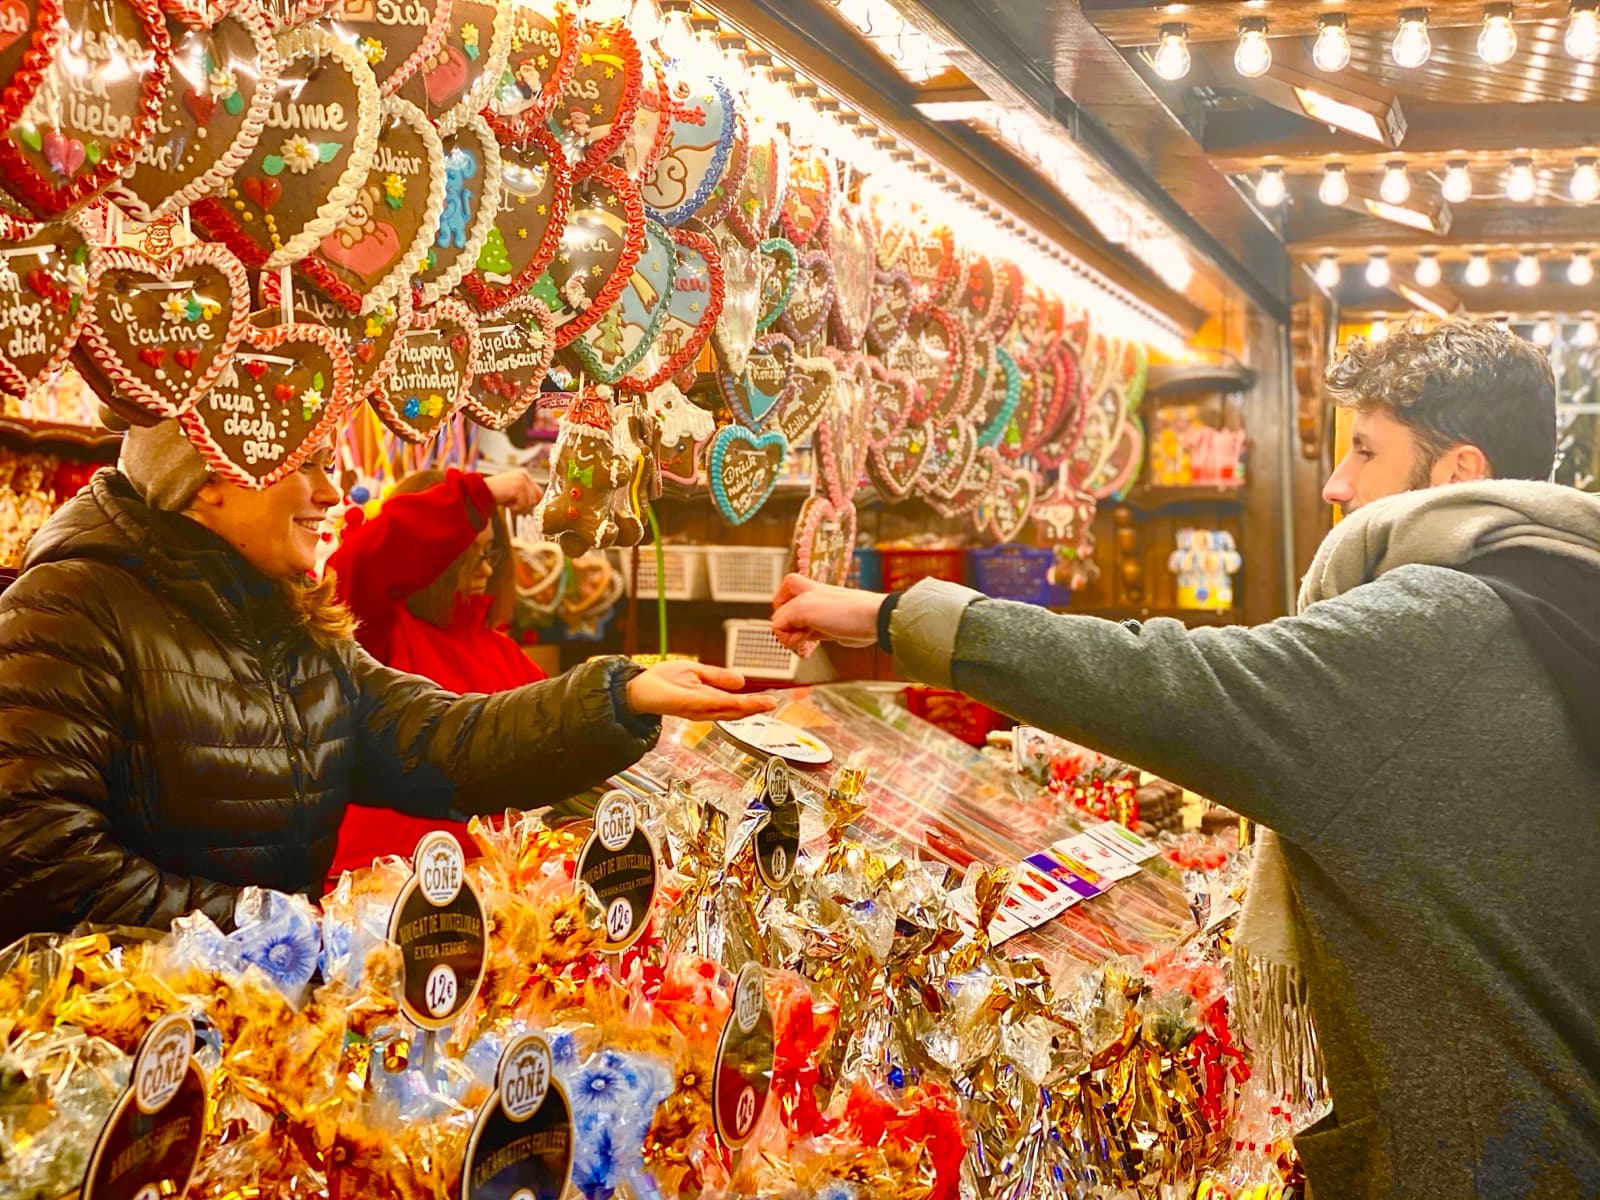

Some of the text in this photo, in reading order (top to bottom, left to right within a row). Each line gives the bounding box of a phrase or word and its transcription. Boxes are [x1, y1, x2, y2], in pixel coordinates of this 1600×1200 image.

[107, 293, 137, 324] Je
[126, 320, 215, 347] t'aime
[400, 337, 455, 372] Happy
[389, 363, 460, 403] birthday
[208, 387, 255, 414] hun
[223, 410, 276, 441] dech
[602, 811, 632, 840] CONÉ
[424, 860, 459, 892] CONÉ
[610, 903, 630, 934] 12€
[429, 974, 454, 1010] 12€
[142, 1046, 185, 1099] CONÉ
[505, 1062, 545, 1107] CONÉ
